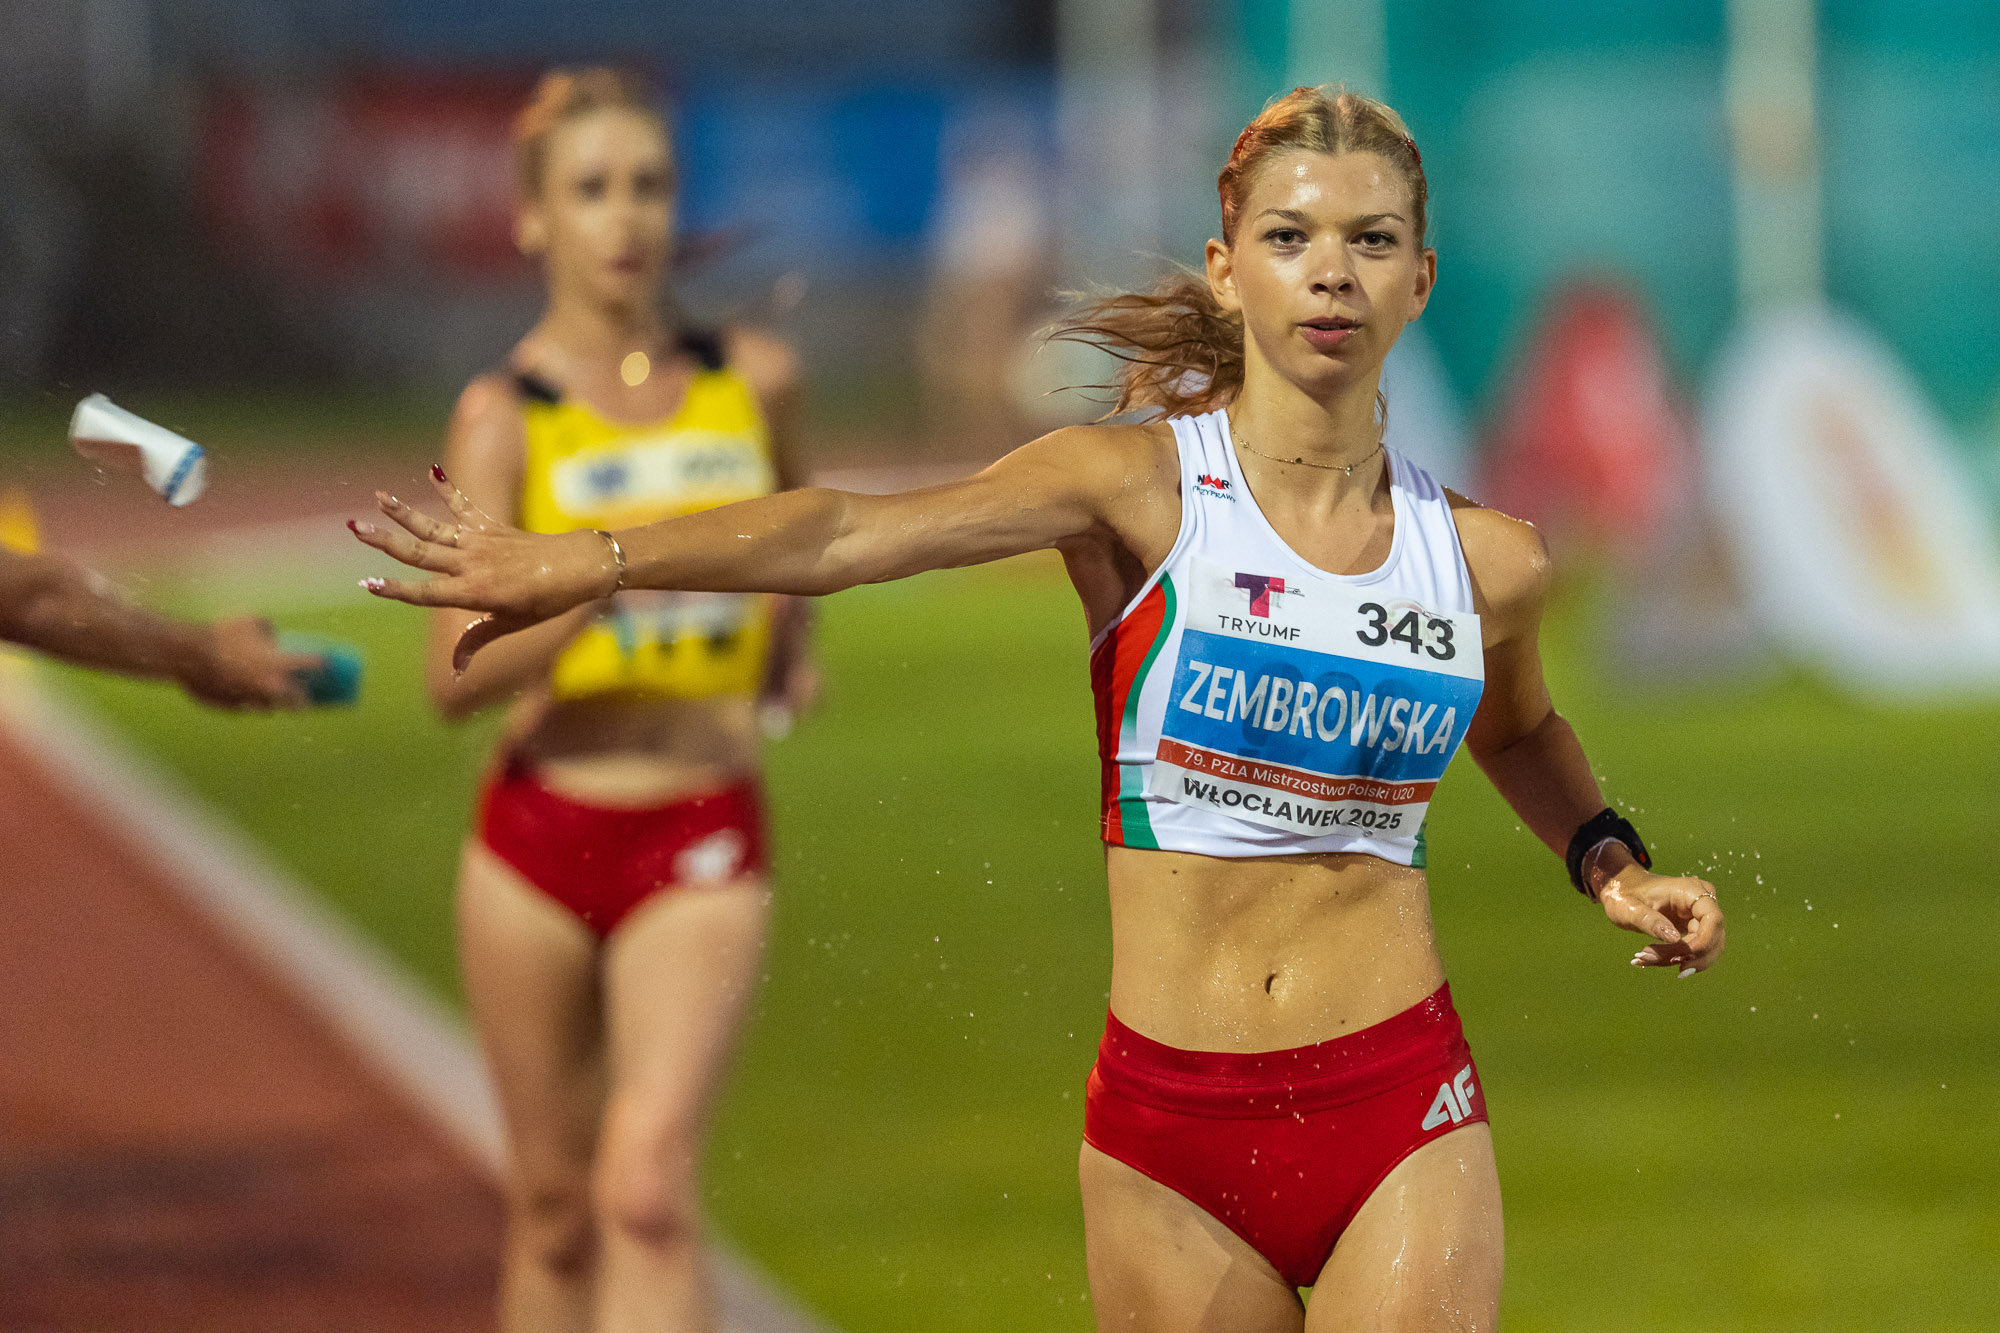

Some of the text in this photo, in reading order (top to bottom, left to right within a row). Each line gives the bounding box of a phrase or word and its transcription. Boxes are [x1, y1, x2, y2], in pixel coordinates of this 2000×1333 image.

[1218, 615, 1301, 641] TRYUMF
[1356, 602, 1456, 661] 343
[1179, 660, 1456, 754] ZEMBROWSKA
[1184, 750, 1415, 800] 79. PZLA Mistrzostwa Polski U20
[1183, 777, 1402, 829] WŁOCŁAWEK 2025
